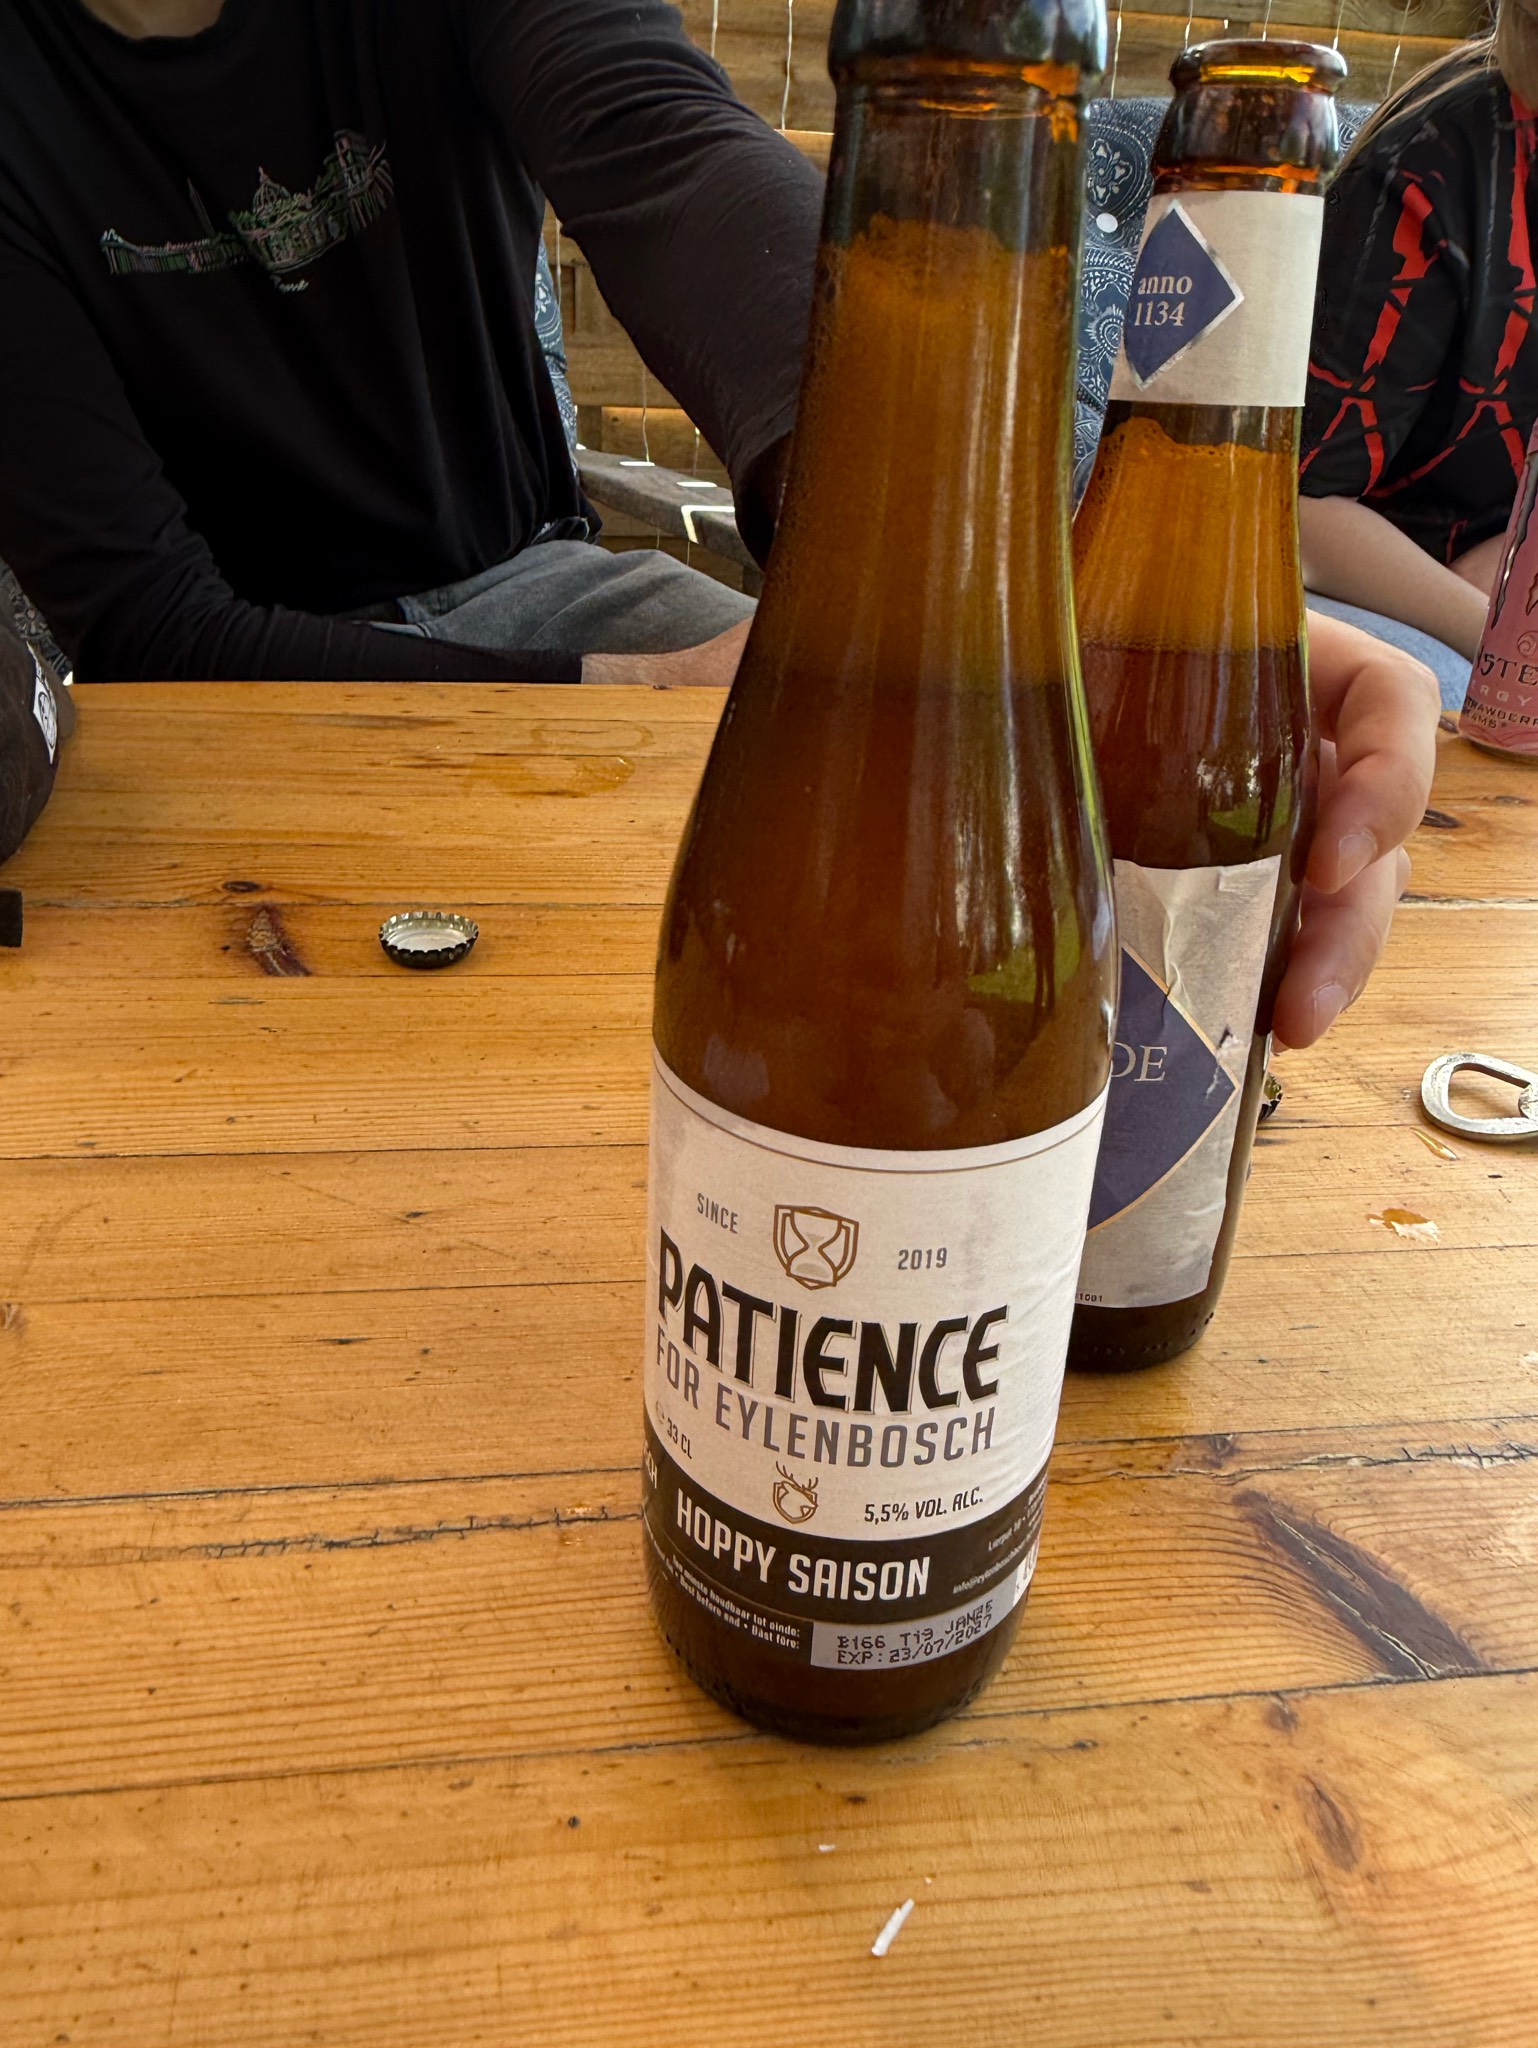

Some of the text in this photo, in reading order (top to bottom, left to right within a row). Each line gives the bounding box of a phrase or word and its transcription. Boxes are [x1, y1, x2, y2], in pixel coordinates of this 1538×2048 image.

[1138, 274, 1193, 295] anno
[1134, 300, 1185, 327] 1134
[697, 1192, 947, 1270] SINCE 2019
[658, 1226, 1009, 1415] PATIENCE
[656, 1323, 996, 1468] FOR EYLENBOSCH
[667, 1416, 692, 1460] 33 CL
[864, 1486, 984, 1525] 5,5% VOL. ALC.
[676, 1487, 777, 1583] HOPPY
[788, 1553, 931, 1602] SAISON
[753, 1612, 767, 1627] tot
